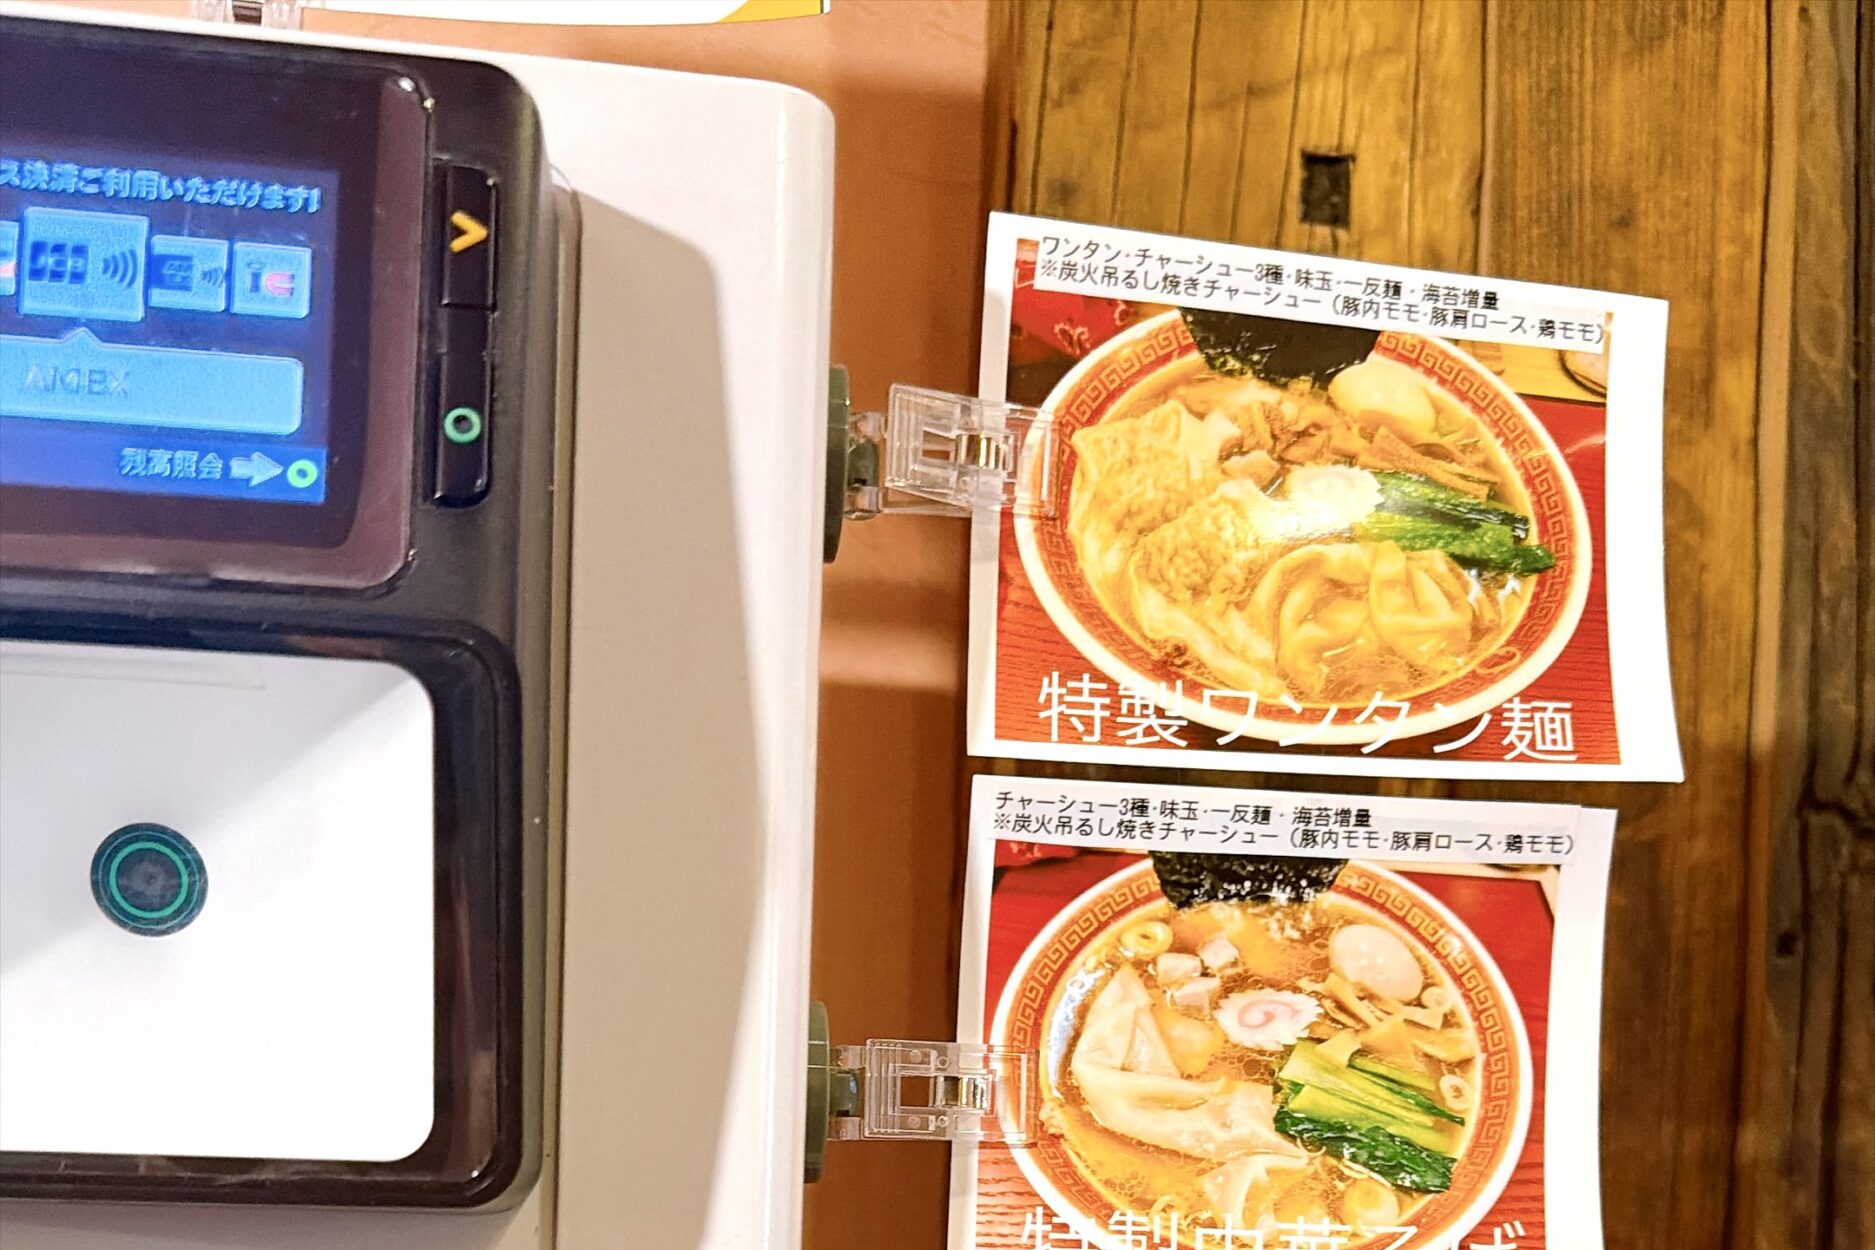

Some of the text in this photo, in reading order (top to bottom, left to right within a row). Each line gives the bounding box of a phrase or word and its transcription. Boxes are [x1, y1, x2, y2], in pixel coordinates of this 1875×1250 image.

[119, 447, 223, 480] 残高照会
[1037, 671, 1578, 762] 特製ワンタン麺
